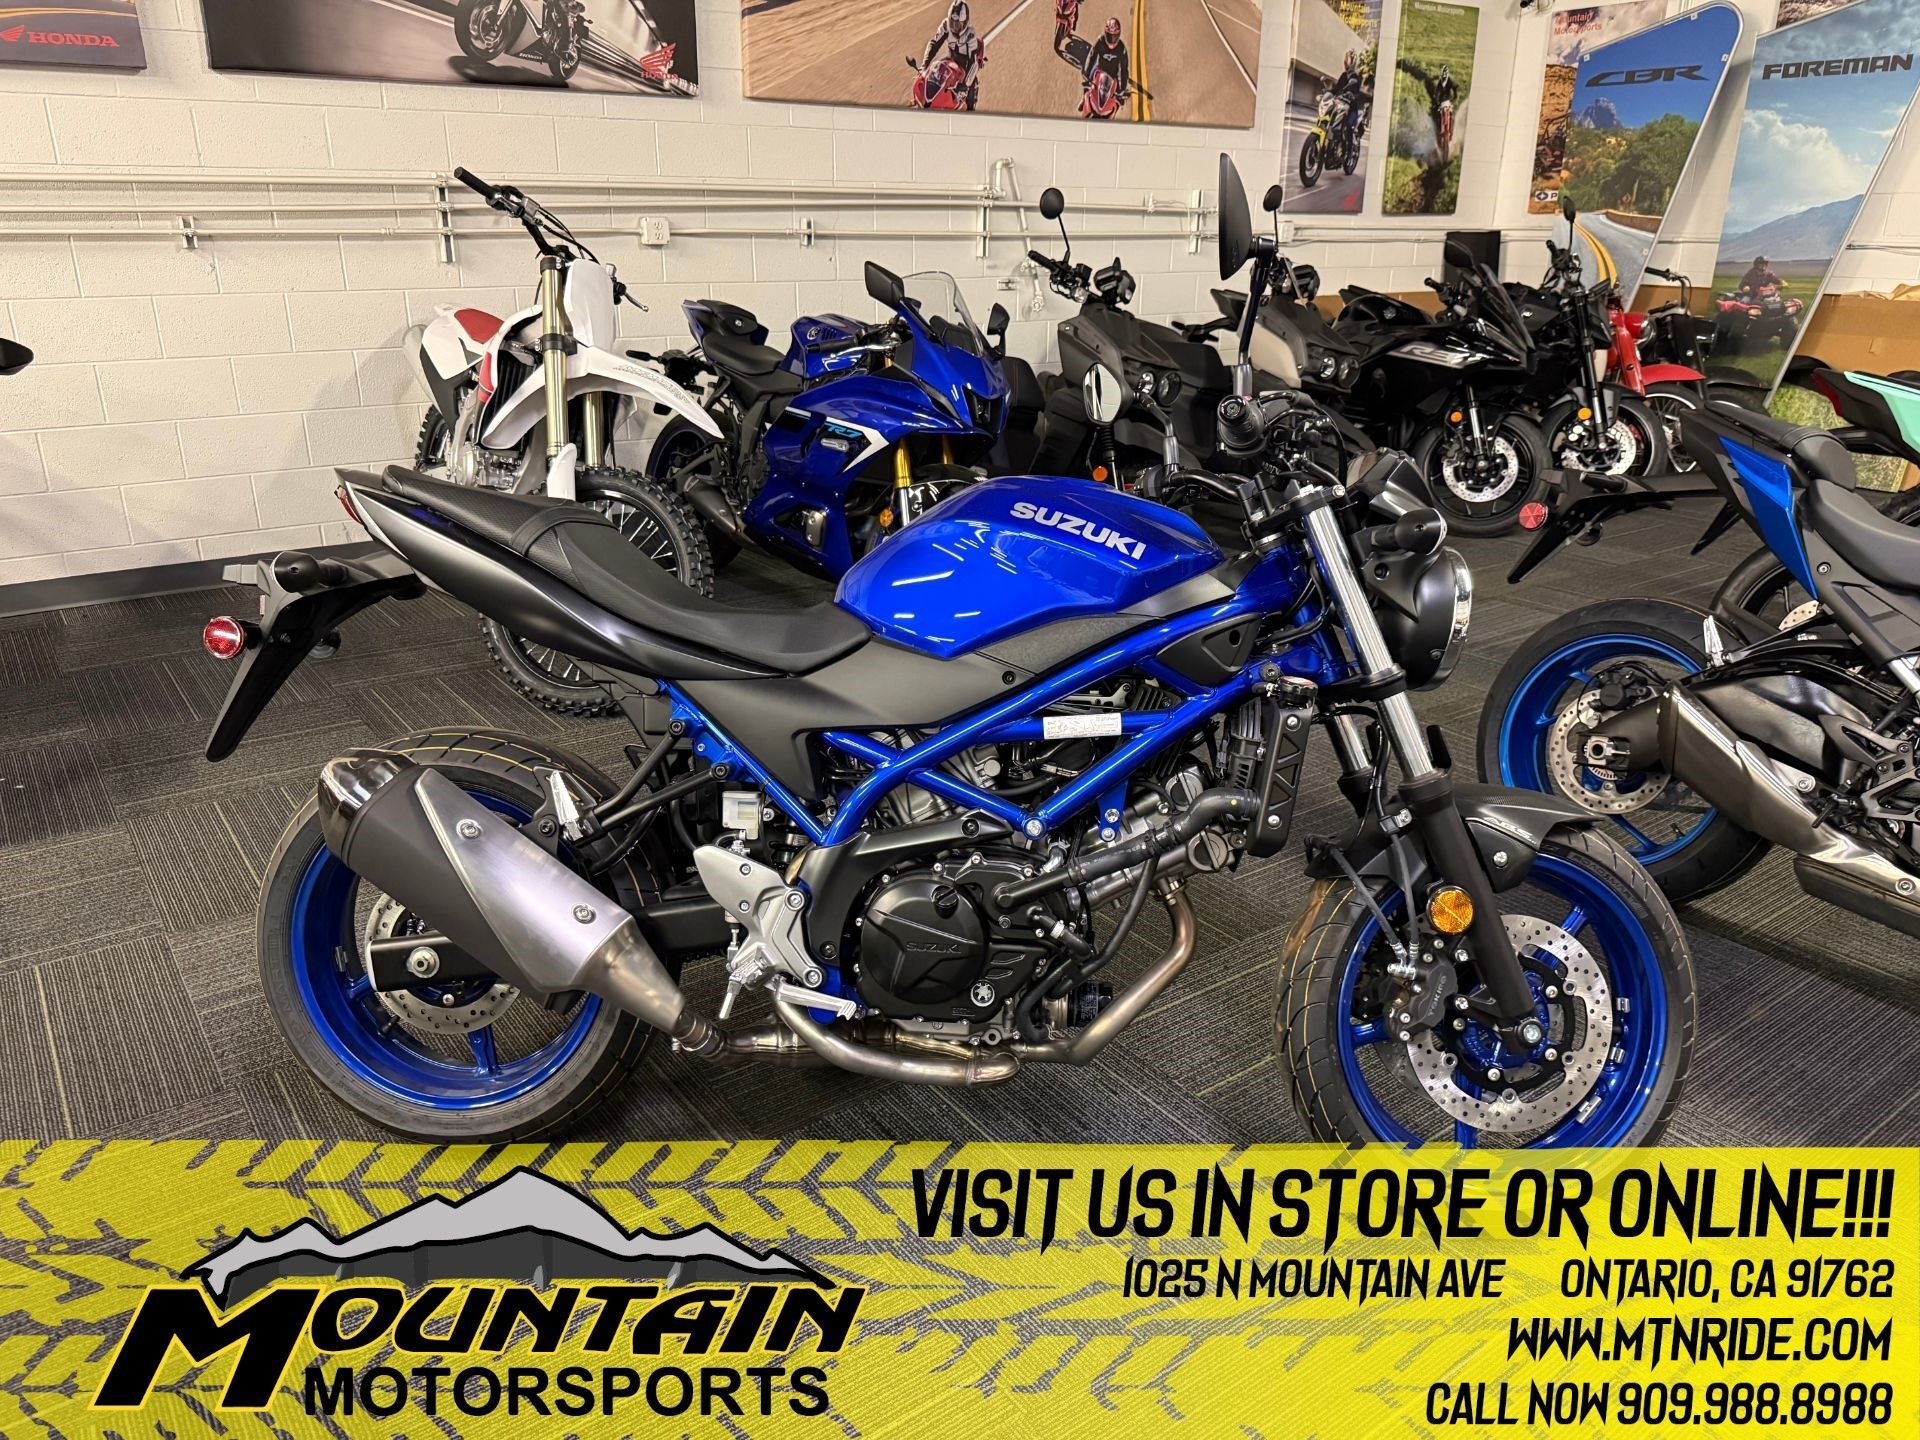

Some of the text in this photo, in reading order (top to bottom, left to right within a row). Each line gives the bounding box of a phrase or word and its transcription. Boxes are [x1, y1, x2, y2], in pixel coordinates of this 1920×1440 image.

[28, 31, 120, 48] HONDA
[1585, 64, 1709, 88] CBR
[1762, 53, 1914, 80] FOREMAN
[1009, 501, 1147, 560] SUZUKI
